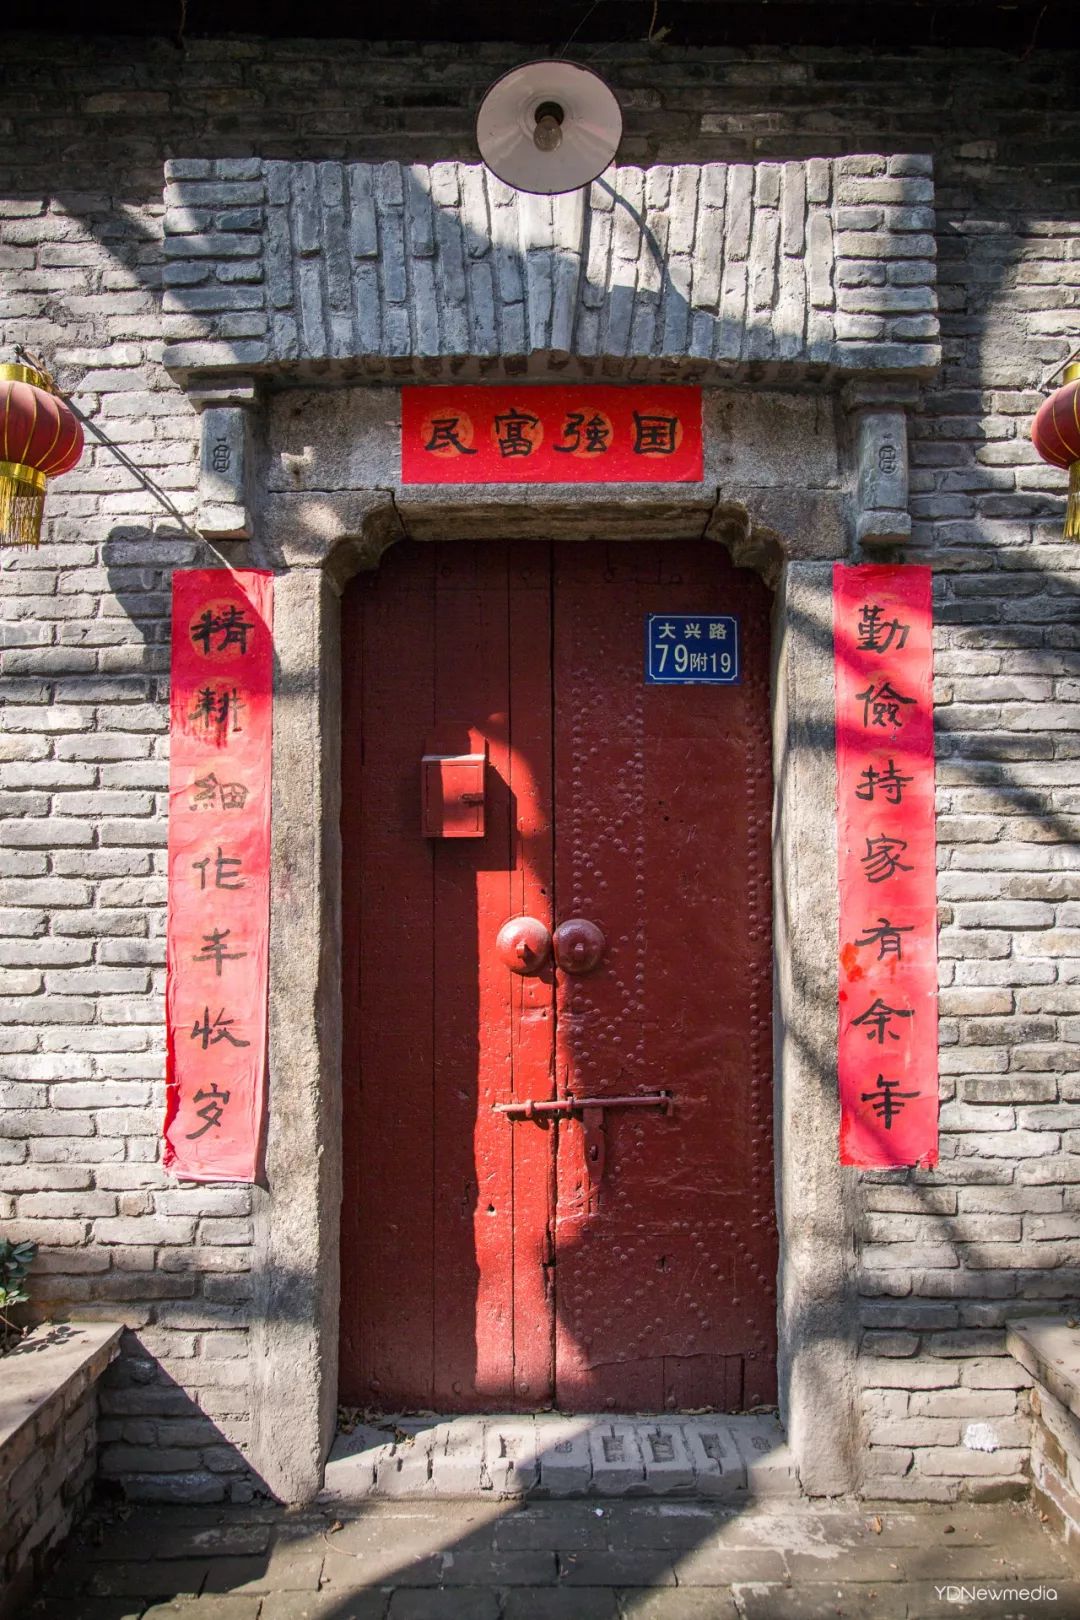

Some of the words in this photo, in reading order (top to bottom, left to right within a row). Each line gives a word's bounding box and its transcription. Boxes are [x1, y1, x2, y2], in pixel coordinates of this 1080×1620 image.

[658, 622, 727, 639] 大兴路
[655, 644, 731, 673] 79附19
